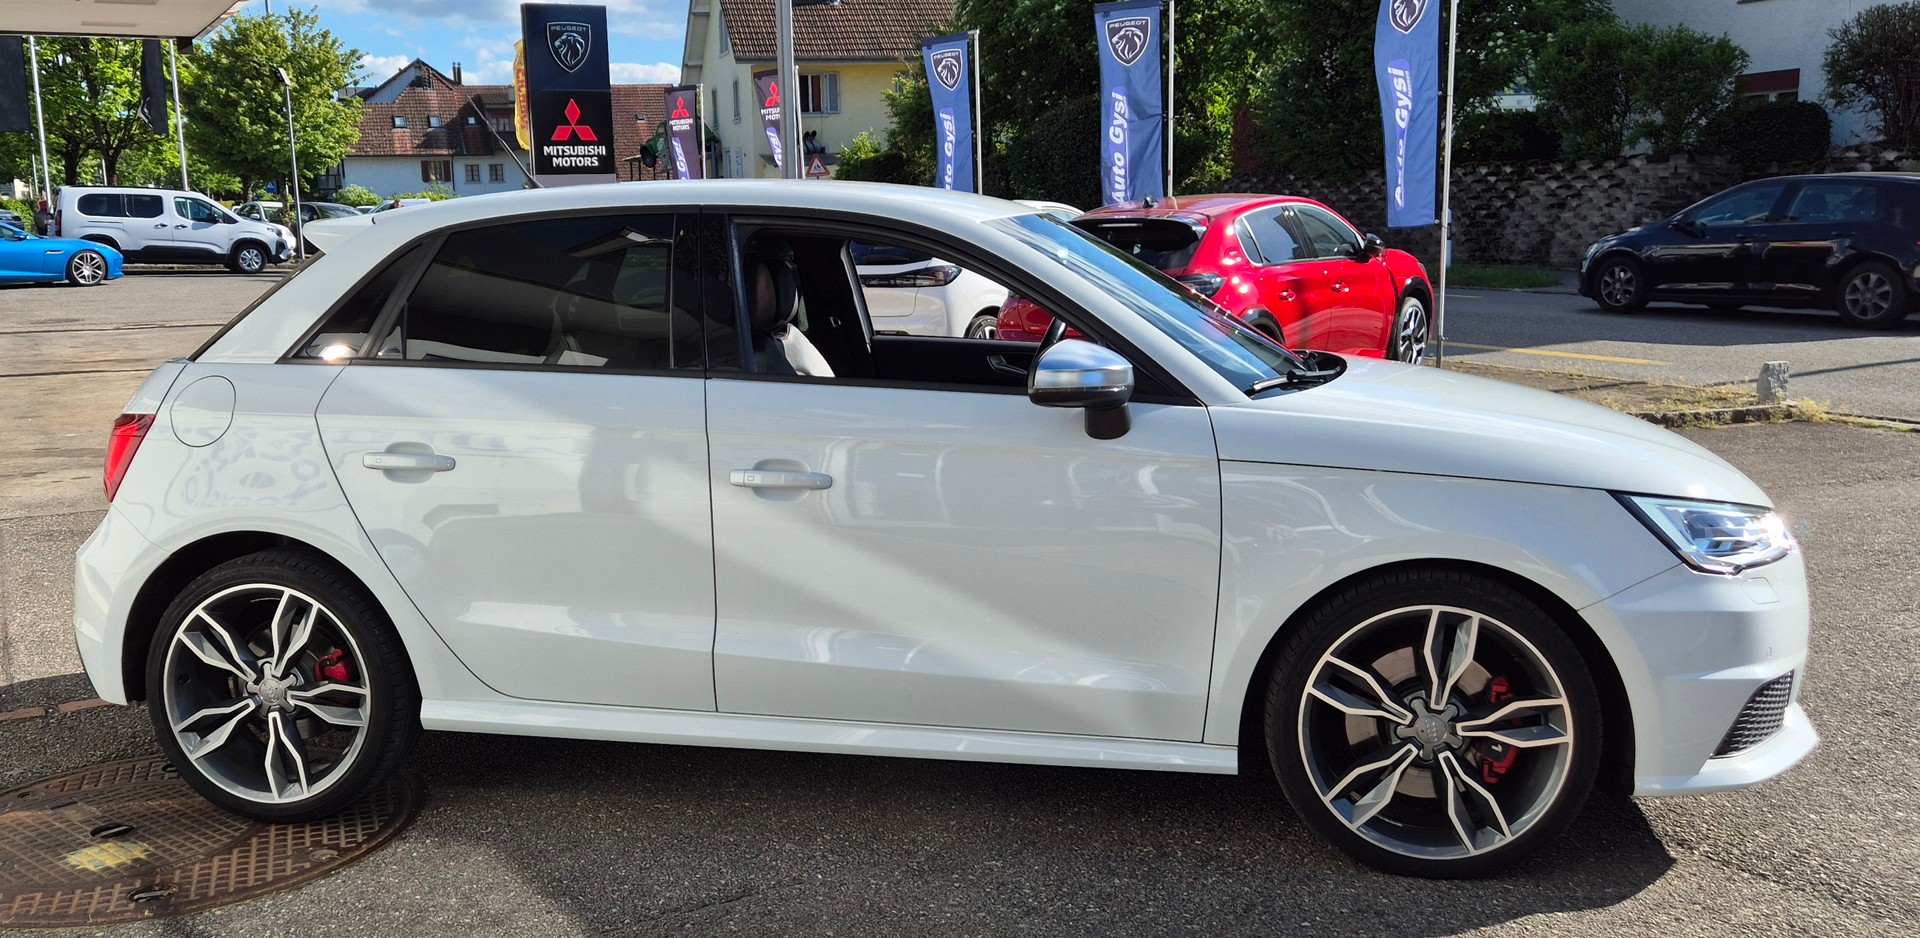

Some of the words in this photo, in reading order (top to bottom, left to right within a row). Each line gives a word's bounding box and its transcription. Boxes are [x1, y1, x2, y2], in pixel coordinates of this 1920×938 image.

[1109, 20, 1147, 29] PEUGEOT
[933, 51, 960, 59] PEUGEOT
[1387, 66, 1412, 129] Gysi
[760, 107, 780, 115] MITSU
[1109, 91, 1128, 145] Gysi
[940, 112, 956, 158] Gysi
[543, 145, 606, 156] MITSUBISHI
[552, 156, 599, 167] MOTORS
[944, 163, 952, 190] to
[1111, 152, 1126, 205] Auto
